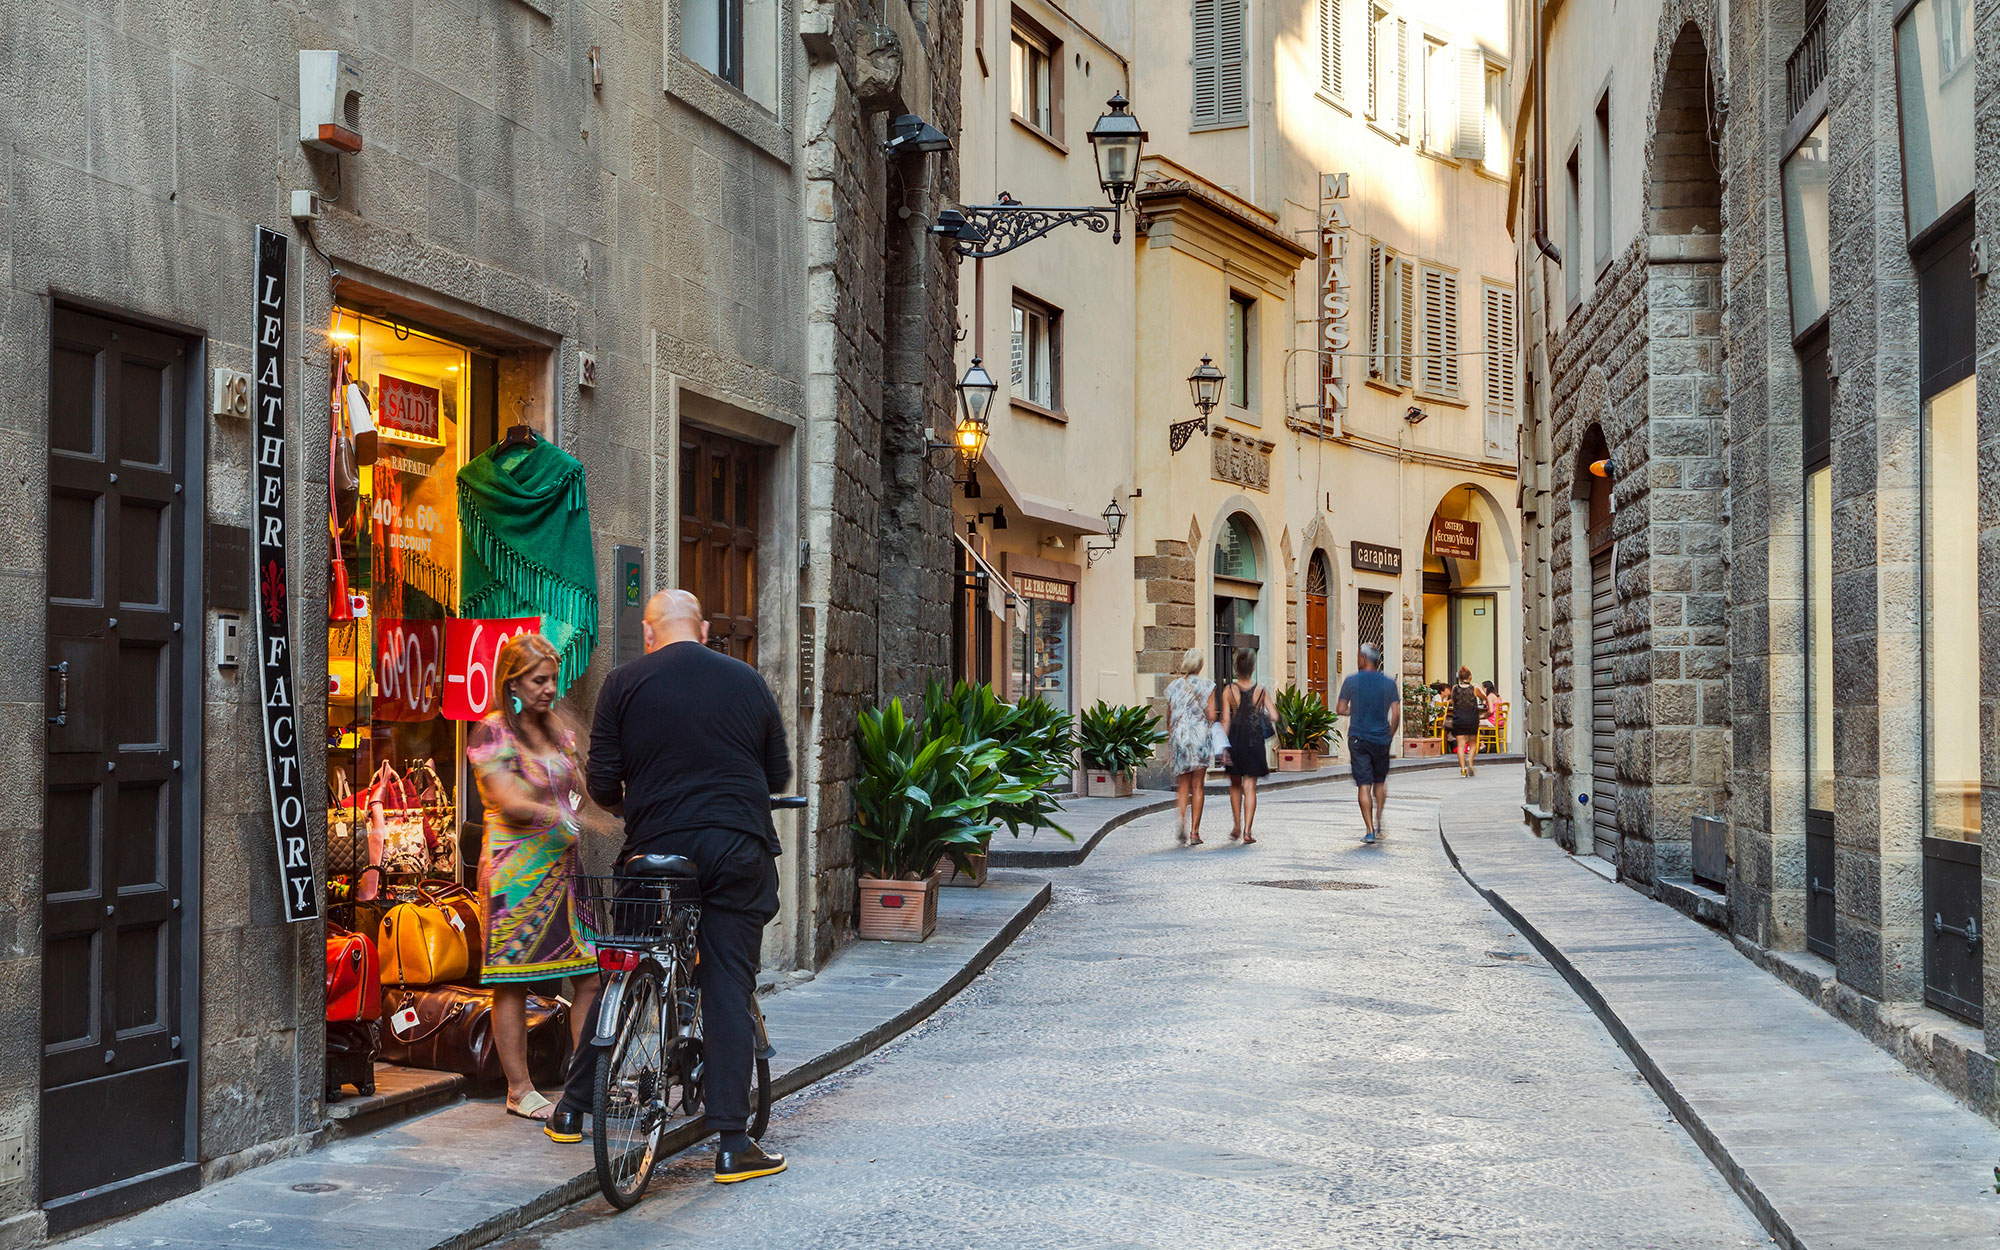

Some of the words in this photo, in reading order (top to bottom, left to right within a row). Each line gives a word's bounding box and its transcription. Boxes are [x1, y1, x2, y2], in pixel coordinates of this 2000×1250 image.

[1322, 173, 1350, 438] MATASSINI
[226, 374, 247, 414] 18
[258, 275, 285, 548] LEATHER
[388, 393, 430, 425] SALDI
[373, 497, 402, 528] 40%
[406, 514, 414, 528] to
[417, 504, 444, 534] 60%
[390, 533, 432, 552] DISCOUNT
[1358, 548, 1398, 568] carapina
[1024, 578, 1033, 591] LE
[267, 635, 312, 911] FACTORY
